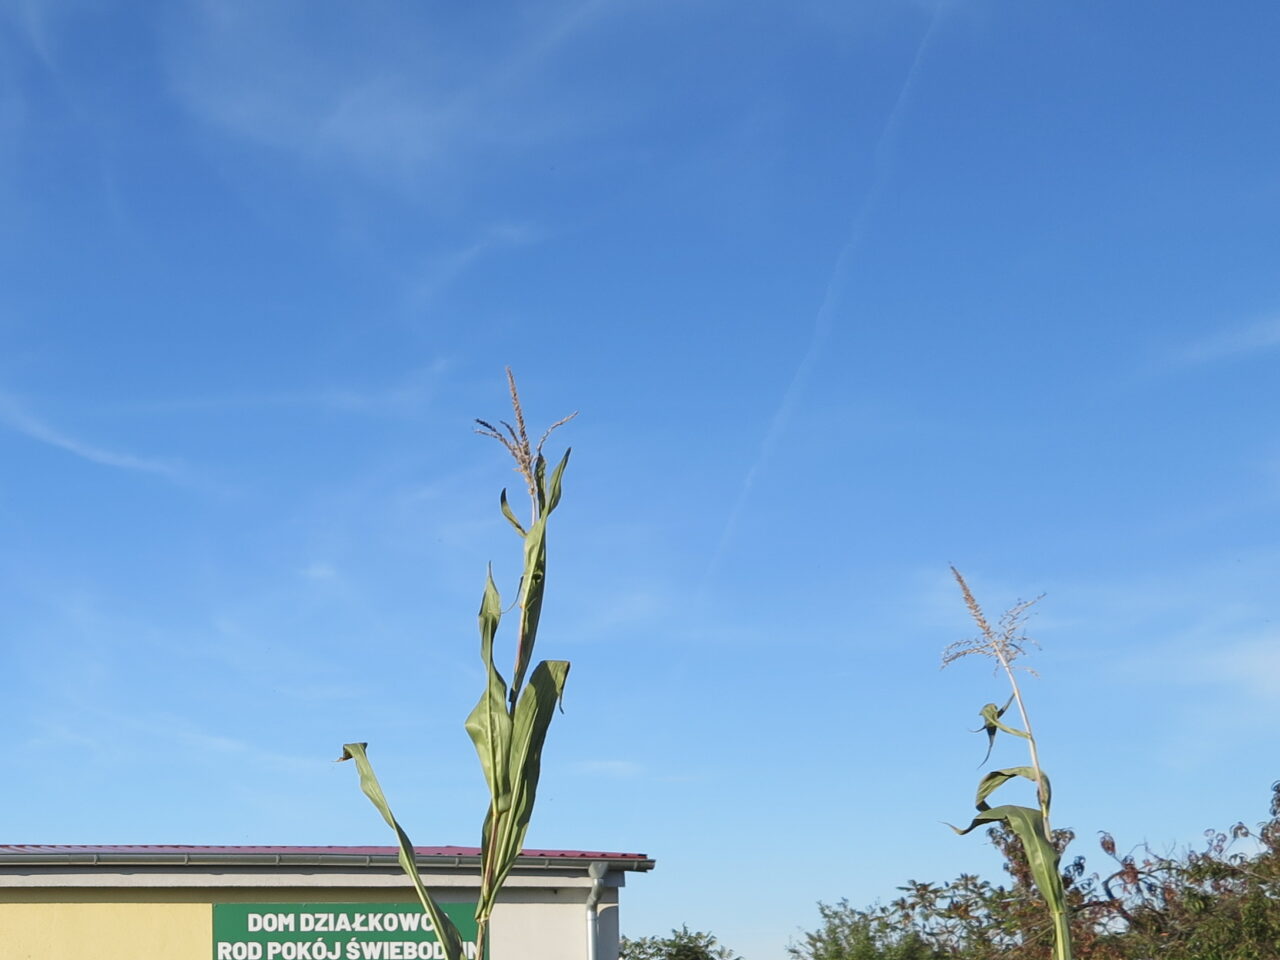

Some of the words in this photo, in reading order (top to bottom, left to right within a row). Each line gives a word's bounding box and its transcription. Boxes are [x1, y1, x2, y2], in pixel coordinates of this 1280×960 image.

[248, 913, 295, 932] DOM
[300, 913, 449, 932] DZIAŁKOWC
[217, 941, 262, 960] ROD
[268, 938, 341, 960] POKÓJ
[346, 937, 478, 960] ŚWIEBODIN
